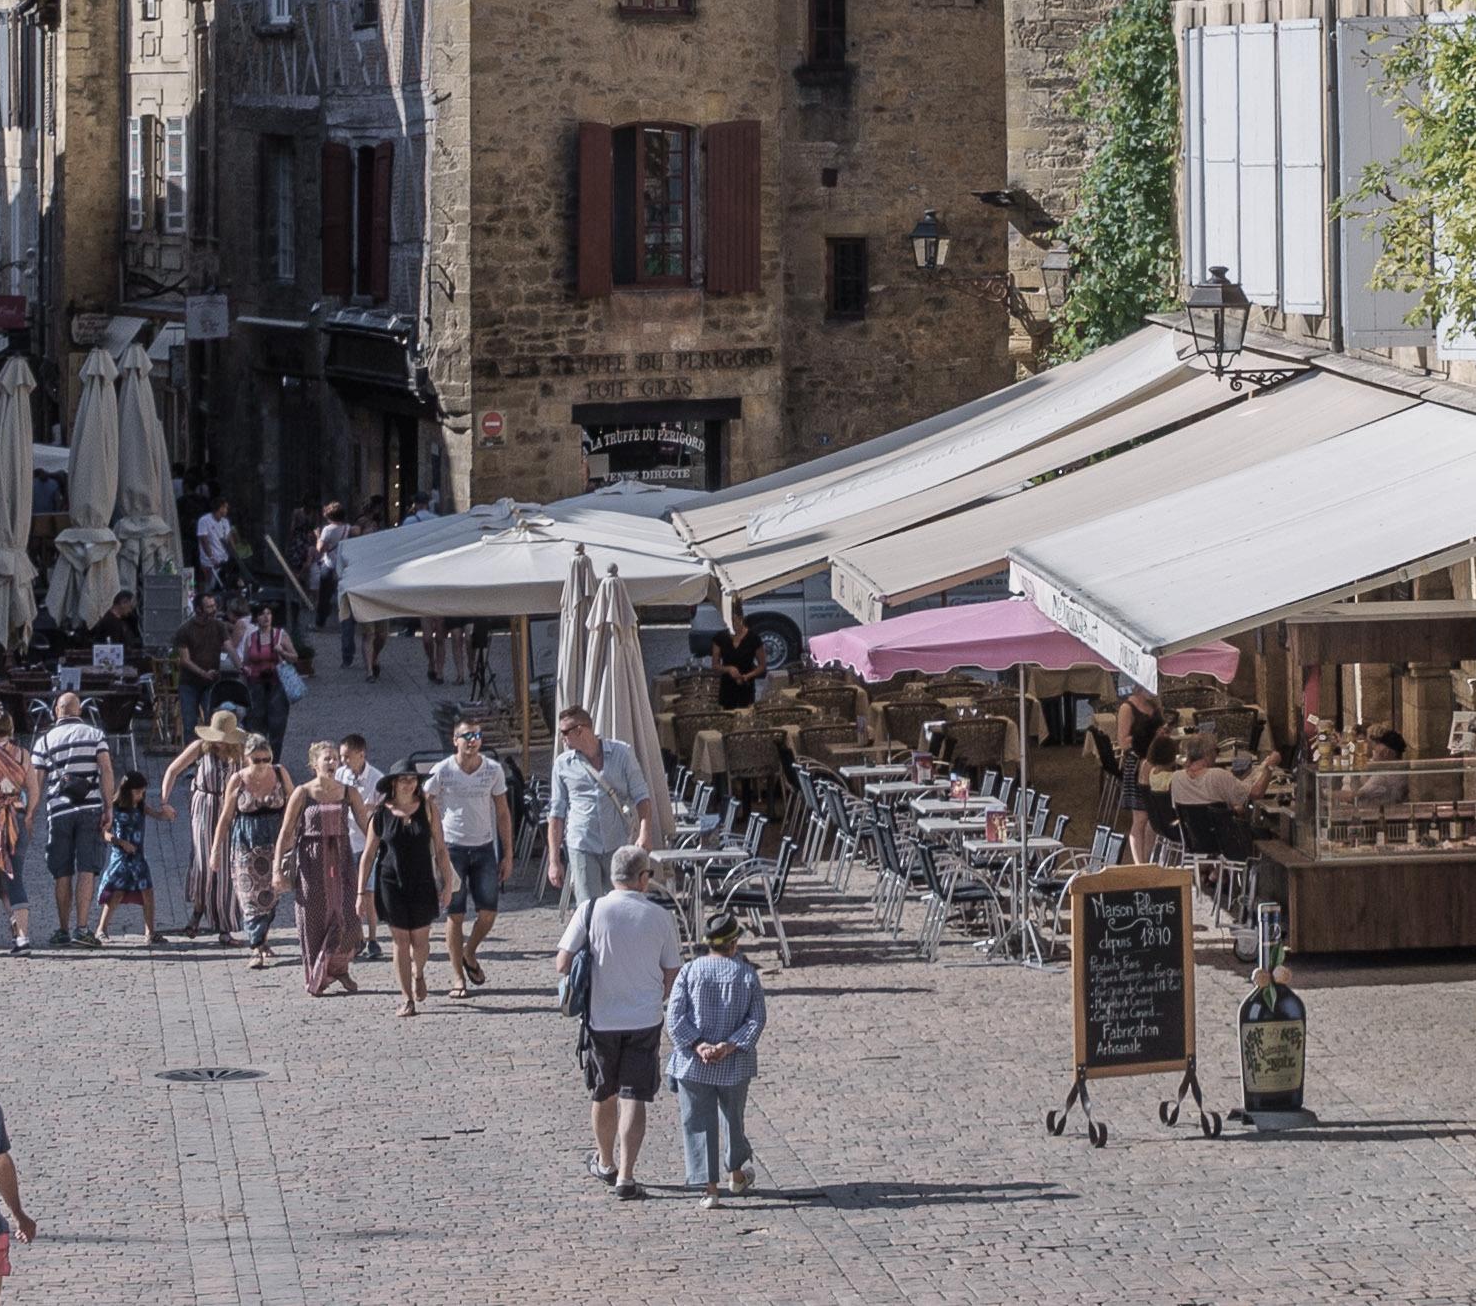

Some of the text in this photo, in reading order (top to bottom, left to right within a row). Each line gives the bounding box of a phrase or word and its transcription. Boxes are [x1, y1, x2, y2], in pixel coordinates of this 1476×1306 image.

[635, 352, 664, 371] DU
[676, 346, 773, 370] PERIGORD
[586, 376, 693, 399] FOIE GRAS
[590, 435, 604, 452] LA
[604, 428, 641, 447] TRUFFE
[642, 427, 656, 442] DU
[642, 468, 691, 481] DIRECTE
[1091, 892, 1134, 918] Maison
[1099, 926, 1171, 956] depuis 1890
[1102, 1018, 1159, 1039] Fabrication
[1096, 1037, 1142, 1055] Artisanale
